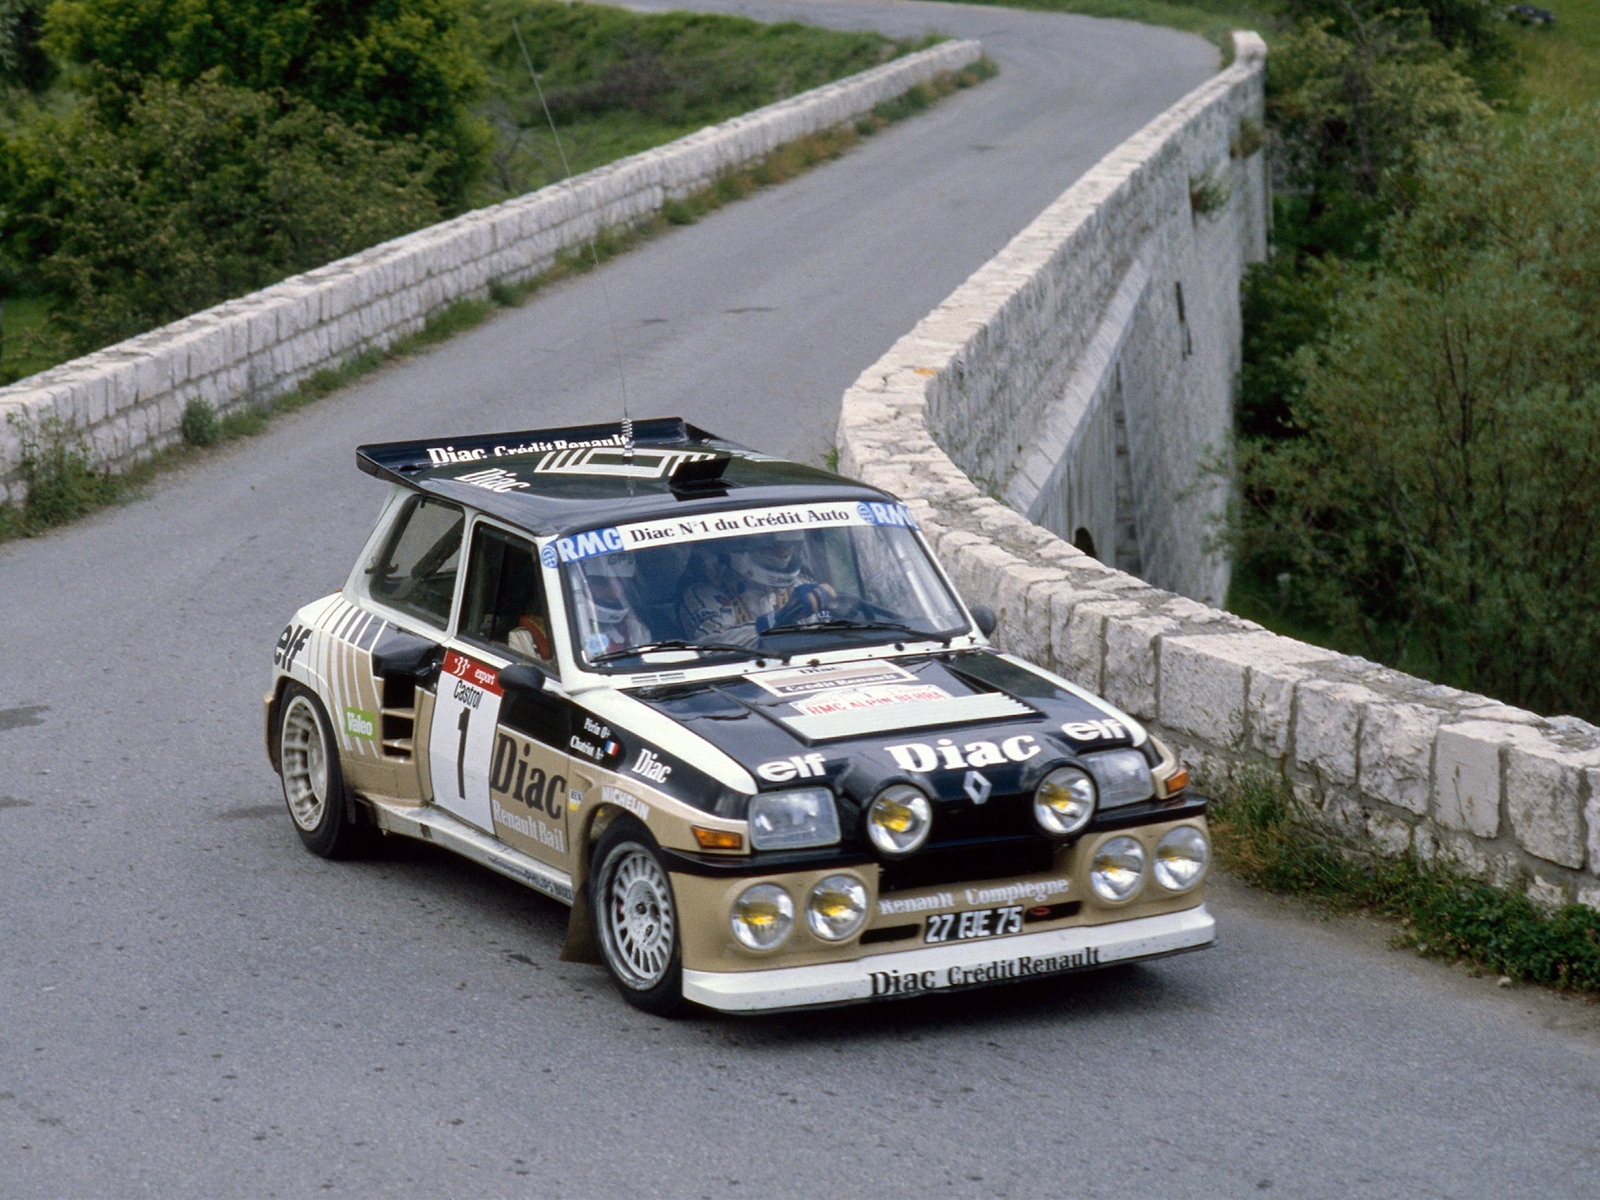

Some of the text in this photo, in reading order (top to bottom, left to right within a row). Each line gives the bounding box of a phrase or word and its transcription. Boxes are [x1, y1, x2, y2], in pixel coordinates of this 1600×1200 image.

[427, 446, 487, 464] Diac
[453, 468, 530, 493] Diac
[630, 529, 675, 543] Diac
[715, 519, 740, 531] du
[743, 511, 804, 529] Crédit
[808, 509, 849, 522] Auto
[556, 528, 621, 562] RMC
[274, 624, 313, 672] elf
[474, 669, 496, 685] export
[785, 674, 897, 692] Crédit Renault
[453, 680, 484, 709] Castrol
[806, 703, 847, 715] RMC
[347, 712, 373, 736] Valeo
[1061, 718, 1127, 740] elf
[457, 707, 471, 800] 1
[631, 748, 672, 784] Diac
[756, 753, 827, 782] elf
[884, 735, 1041, 772] Diac
[490, 732, 567, 820] Diac
[601, 785, 649, 821] MICHELIN
[492, 799, 565, 853] Renault Bail
[878, 892, 955, 915] Renault
[926, 914, 955, 943] 27
[996, 905, 1023, 934] 75
[869, 946, 1101, 996] Diac Crédit Renault
